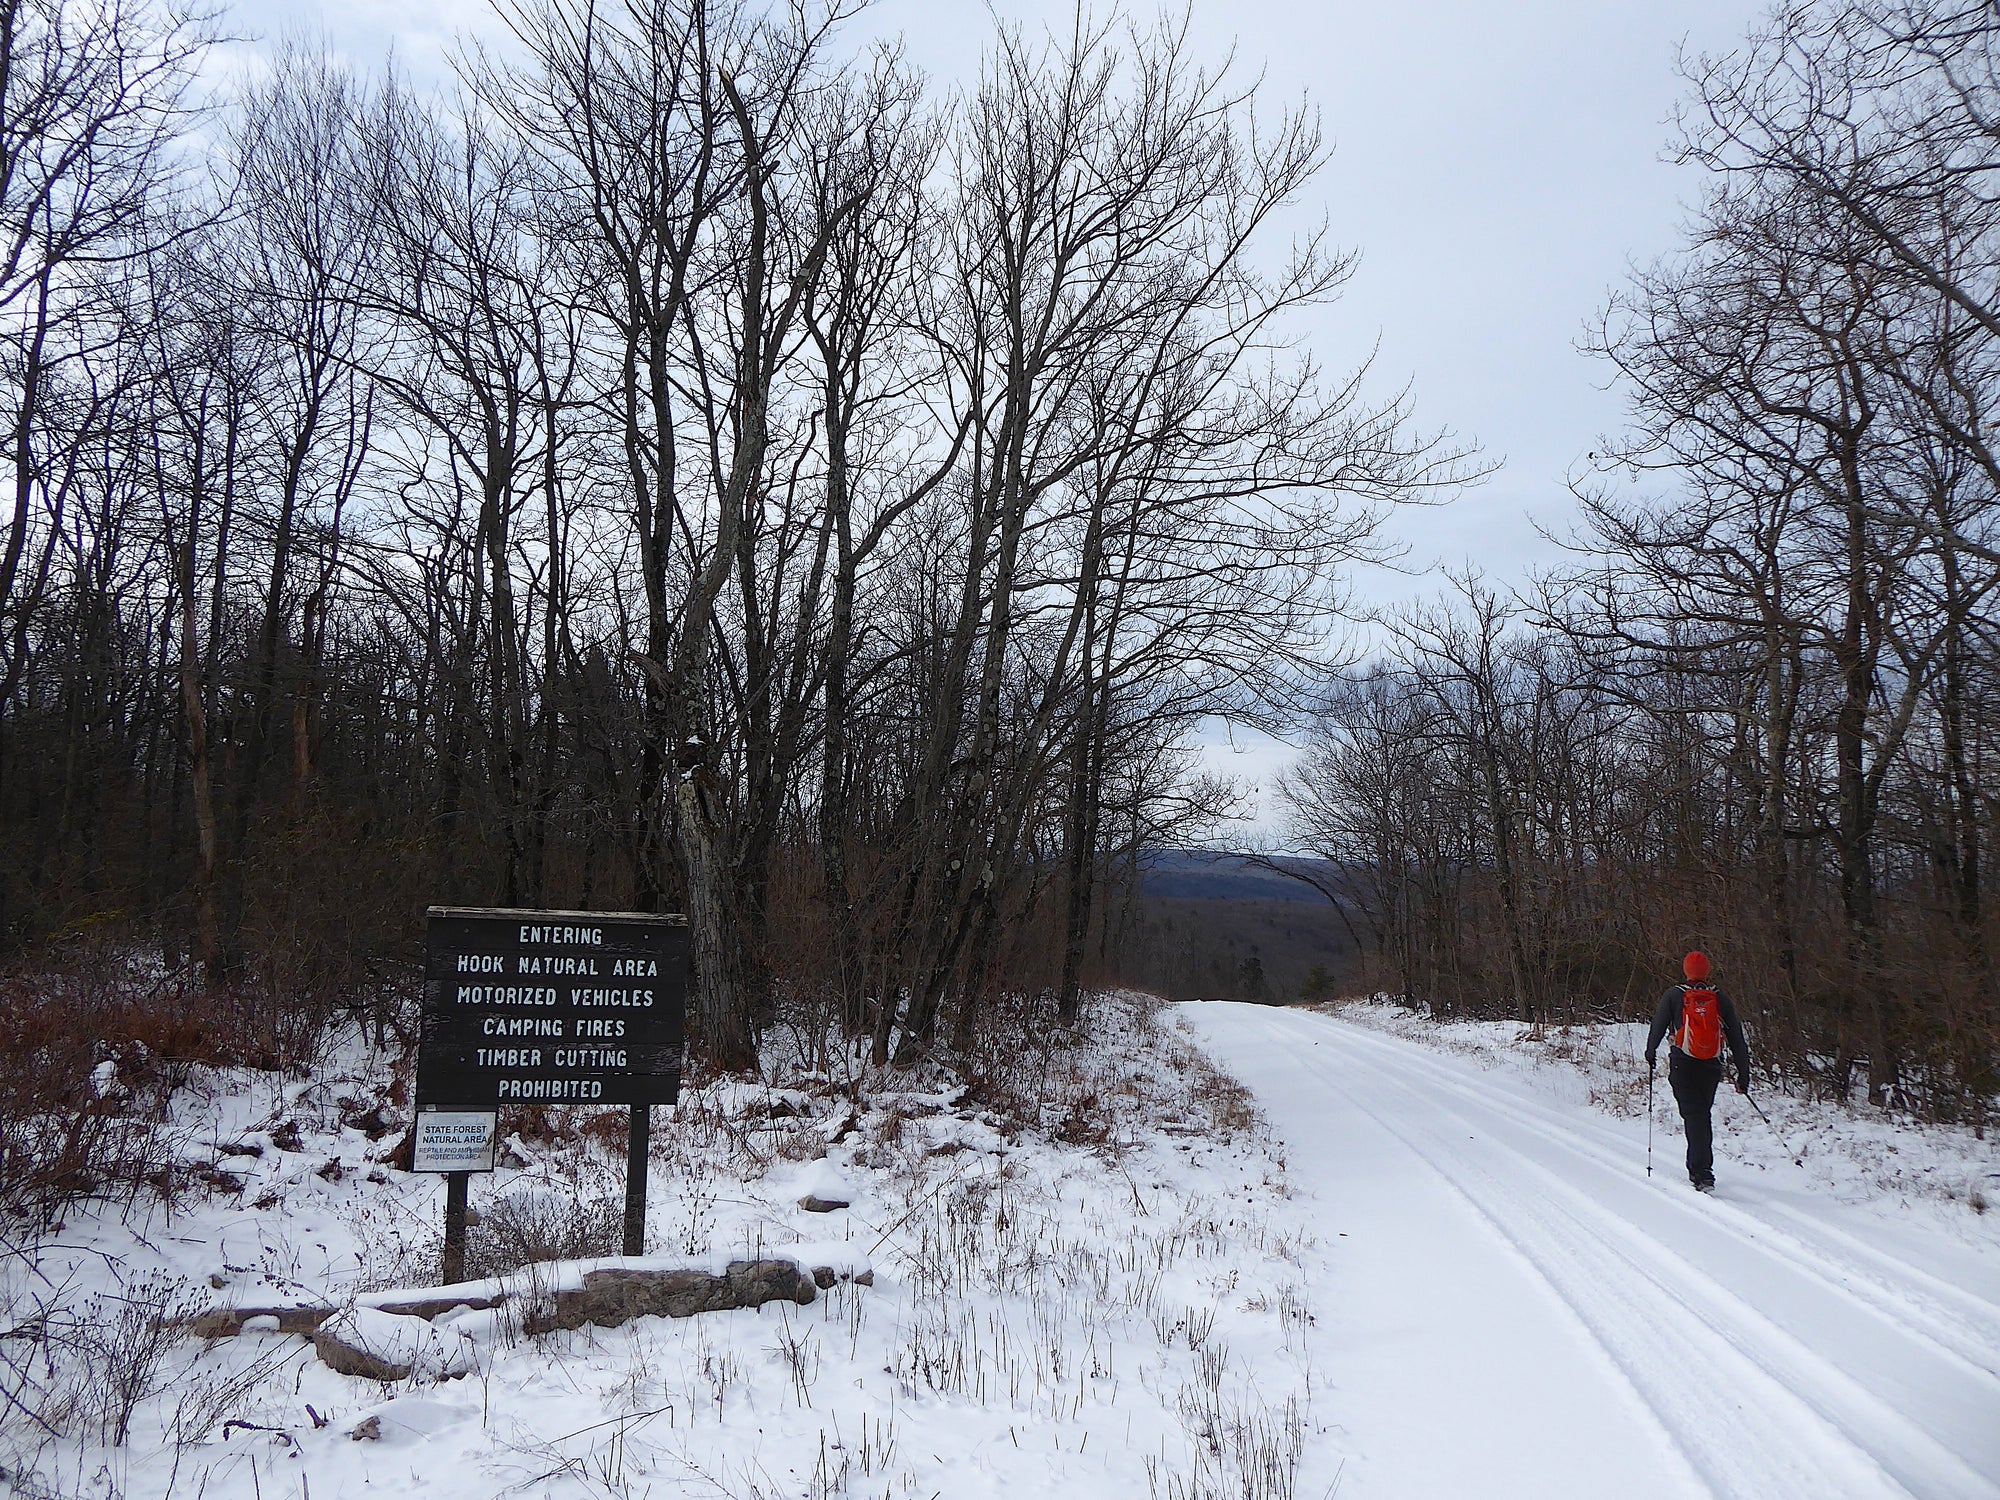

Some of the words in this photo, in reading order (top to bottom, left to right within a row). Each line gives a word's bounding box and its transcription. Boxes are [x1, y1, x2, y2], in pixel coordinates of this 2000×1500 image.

[520, 926, 602, 945] ENTERING
[457, 955, 504, 973] HOOK
[519, 957, 599, 975] NATURAL
[612, 959, 658, 977] AREA
[457, 986, 557, 1006] MOTORIZED
[571, 988, 654, 1007] VEHICLES
[483, 1018, 563, 1037] CAMPING
[576, 1019, 625, 1037] FIRES
[477, 1048, 541, 1067] TIMBER
[555, 1049, 627, 1067] CUTTING
[498, 1080, 602, 1098] PROHIBITED
[425, 1125, 451, 1133] STATE
[453, 1125, 487, 1133] FOREST
